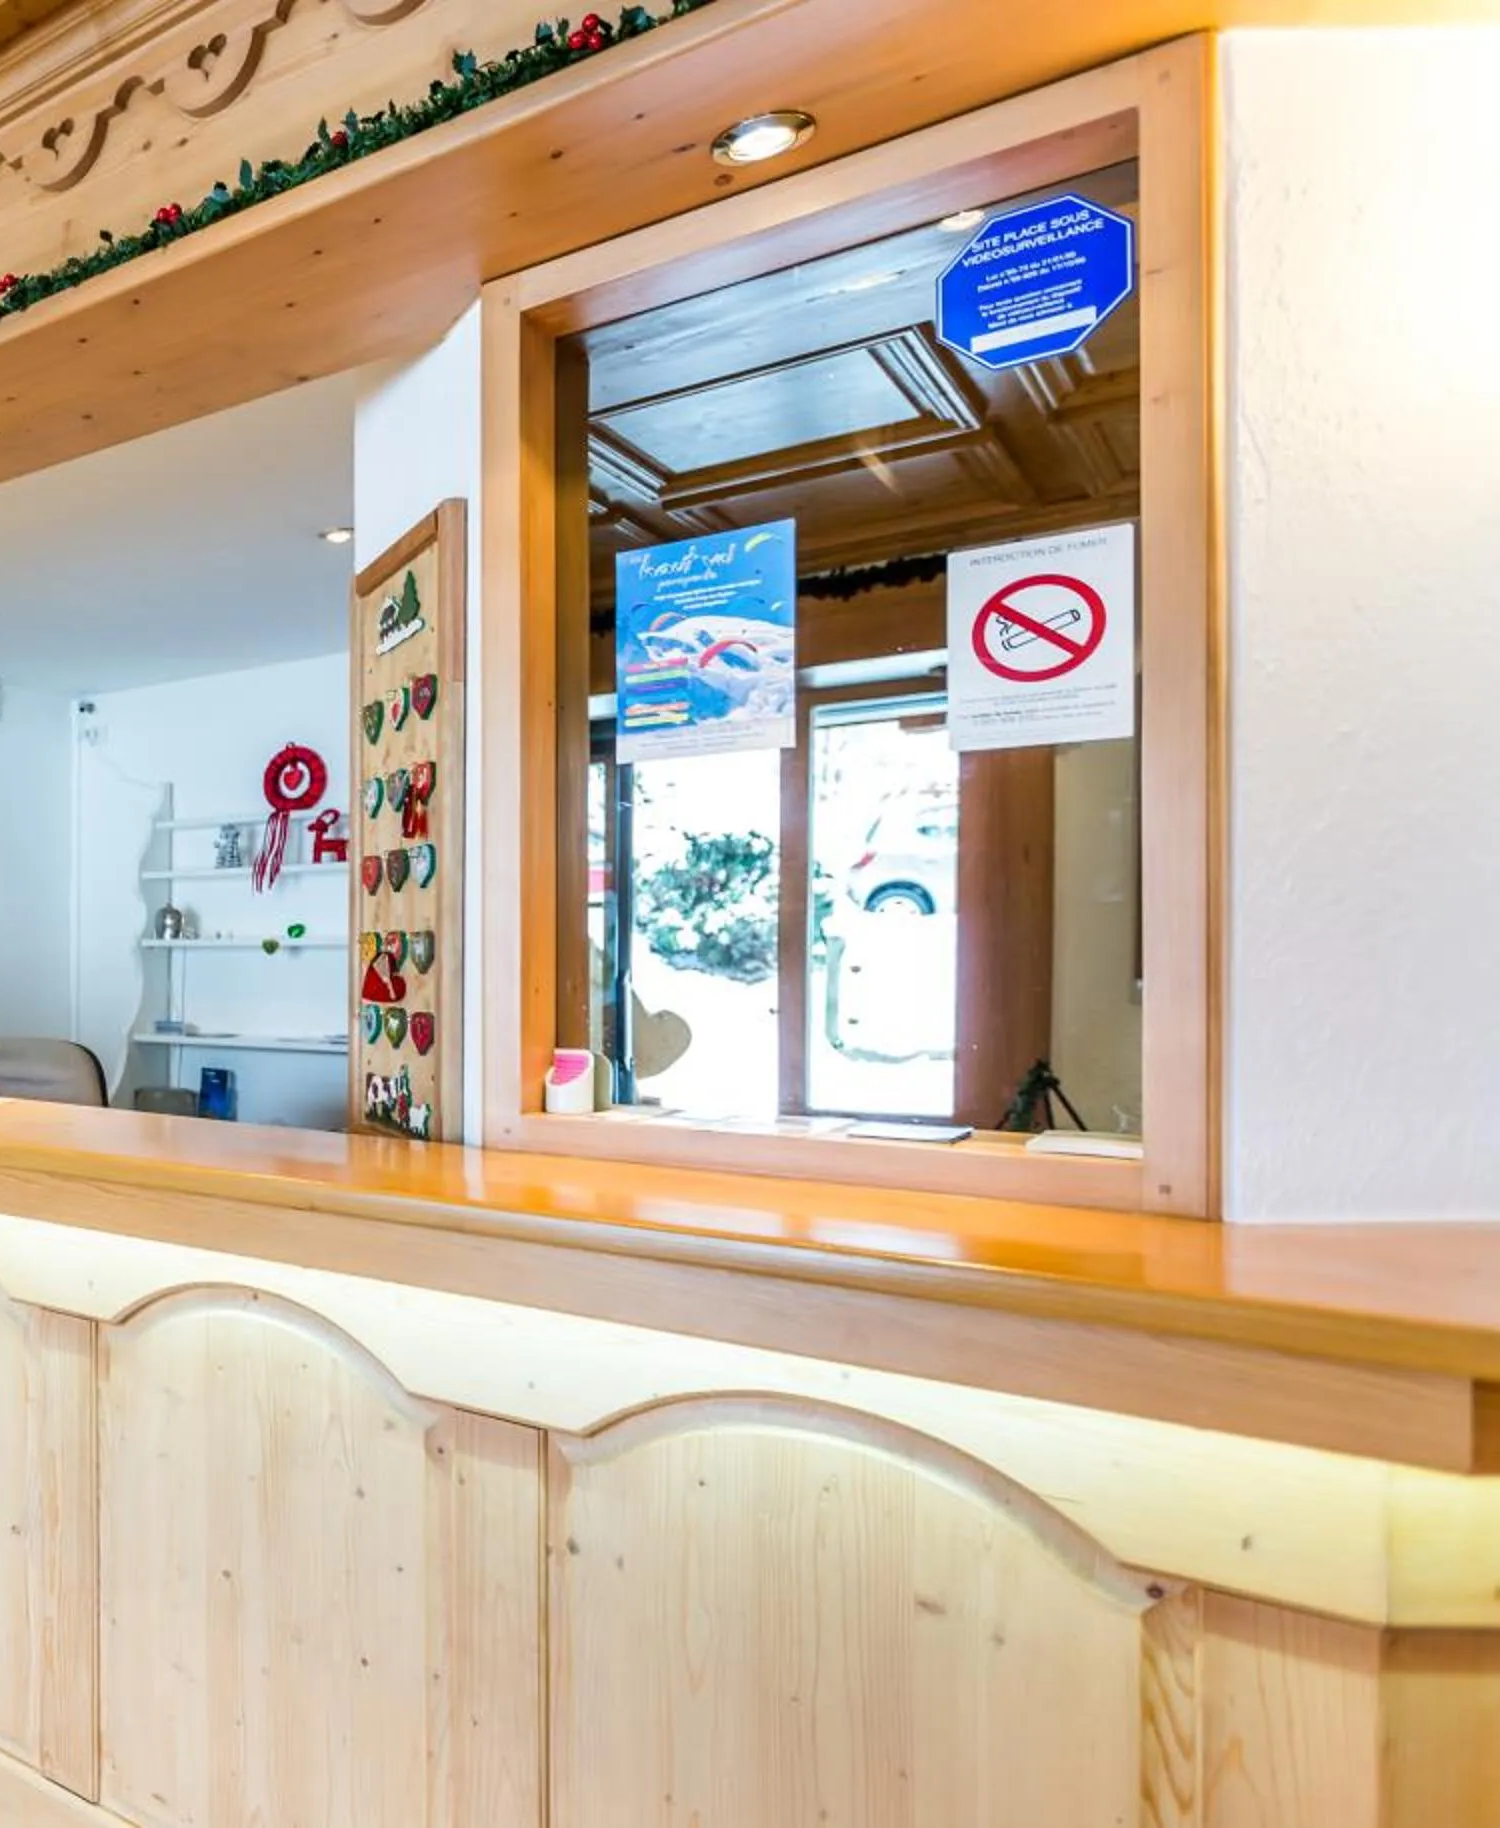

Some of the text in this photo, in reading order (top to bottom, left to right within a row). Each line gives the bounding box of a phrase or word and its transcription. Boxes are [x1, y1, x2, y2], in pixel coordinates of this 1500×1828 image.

[961, 218, 1104, 267] VIDEOSURVEILLANCE
[971, 209, 1090, 252] SITE PLACE SOUS
[969, 548, 1046, 567] INTERDICTION
